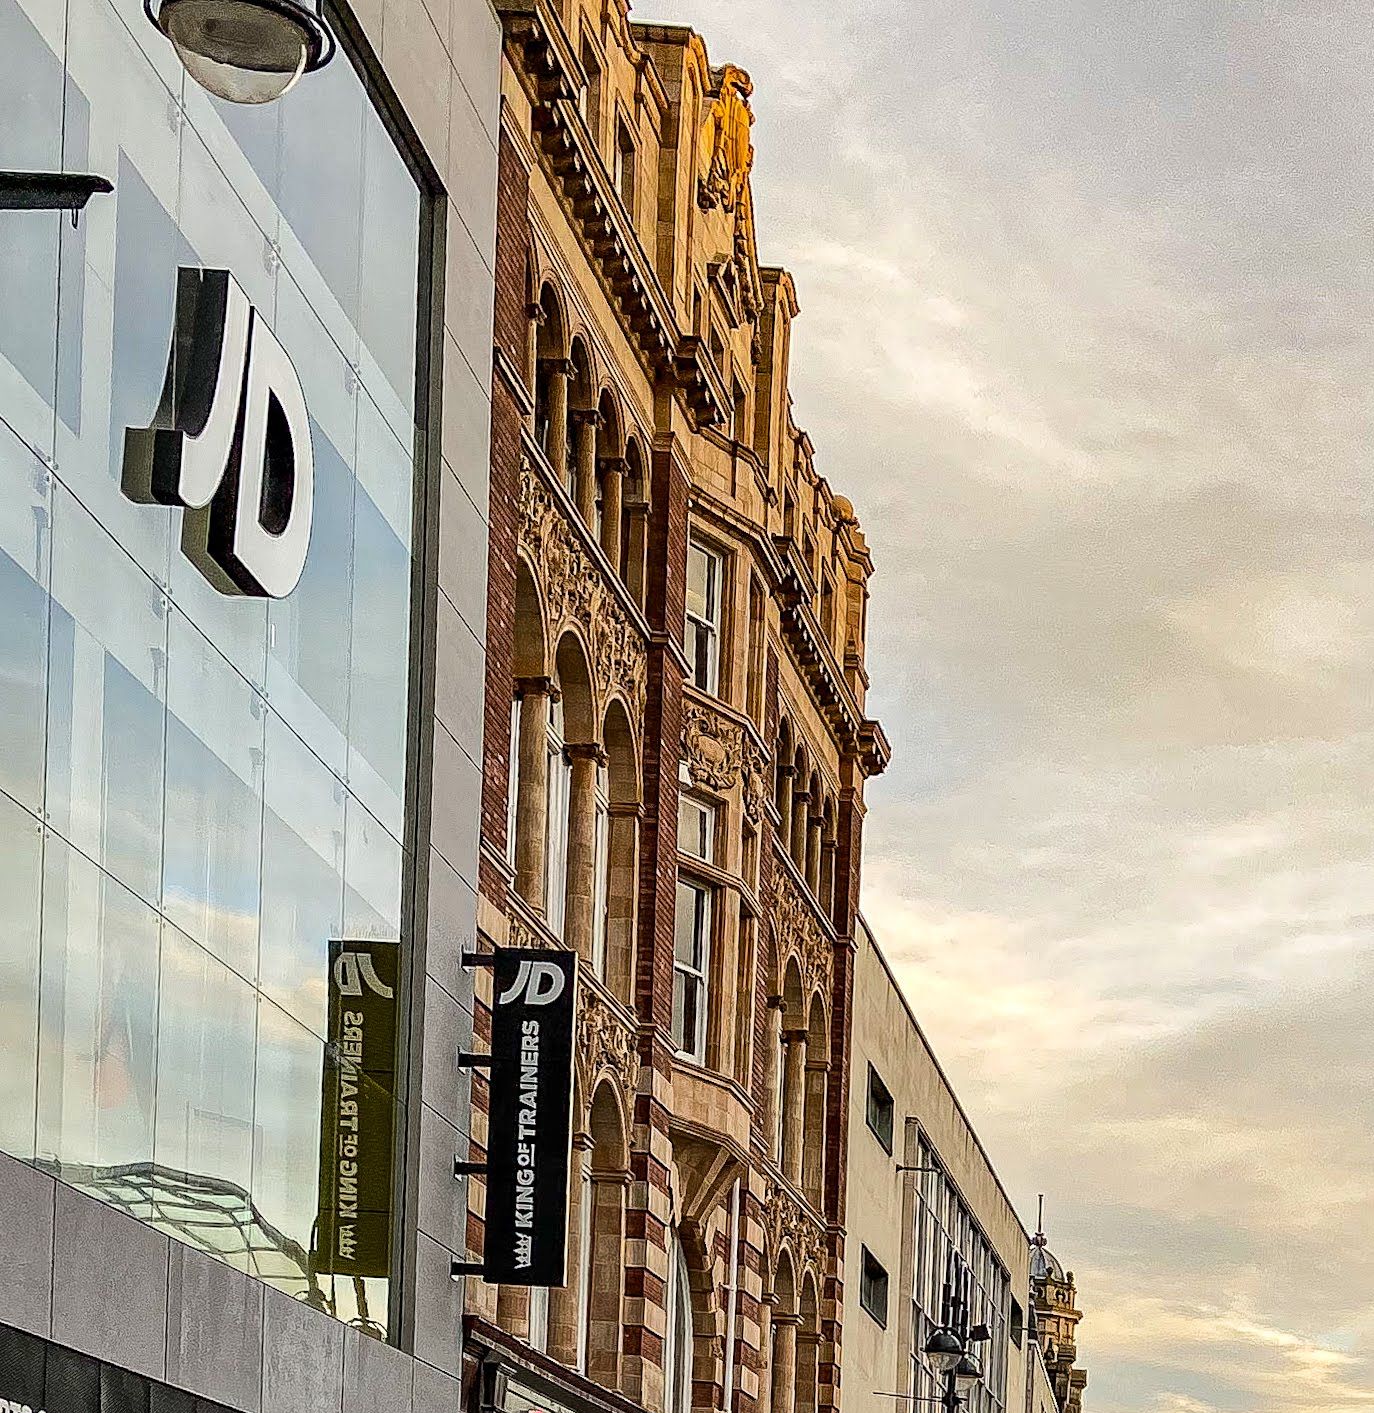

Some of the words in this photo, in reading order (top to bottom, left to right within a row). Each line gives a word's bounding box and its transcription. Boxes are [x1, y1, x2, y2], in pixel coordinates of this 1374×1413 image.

[150, 268, 314, 600] JD
[499, 960, 566, 1006] JD
[518, 1020, 540, 1140] TRAINERS
[516, 1142, 535, 1167] OF
[515, 1168, 535, 1228] KING
